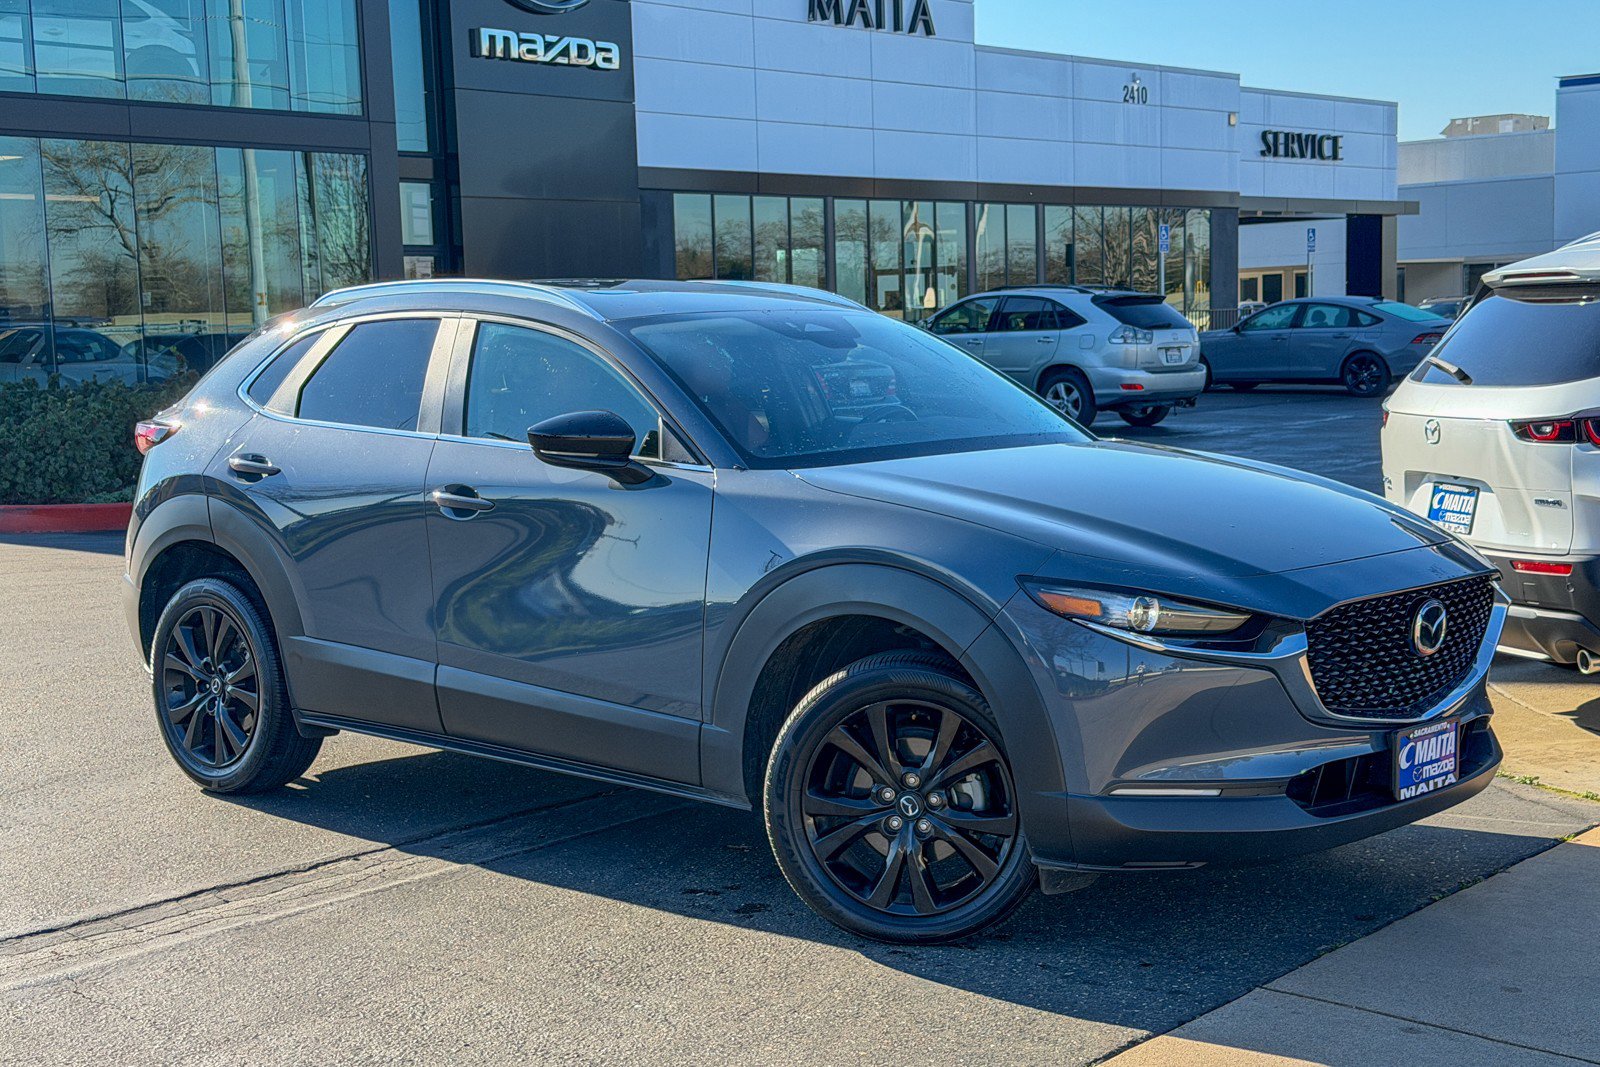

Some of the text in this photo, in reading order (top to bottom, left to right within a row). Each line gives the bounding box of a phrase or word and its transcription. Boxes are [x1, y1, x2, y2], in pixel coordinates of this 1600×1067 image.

[472, 27, 620, 70] mazda
[1122, 85, 1148, 104] 2410
[1260, 129, 1344, 161] SERVICE
[1441, 493, 1475, 513] MAITA
[1422, 756, 1455, 779] mazda
[1400, 773, 1457, 801] MAITA
